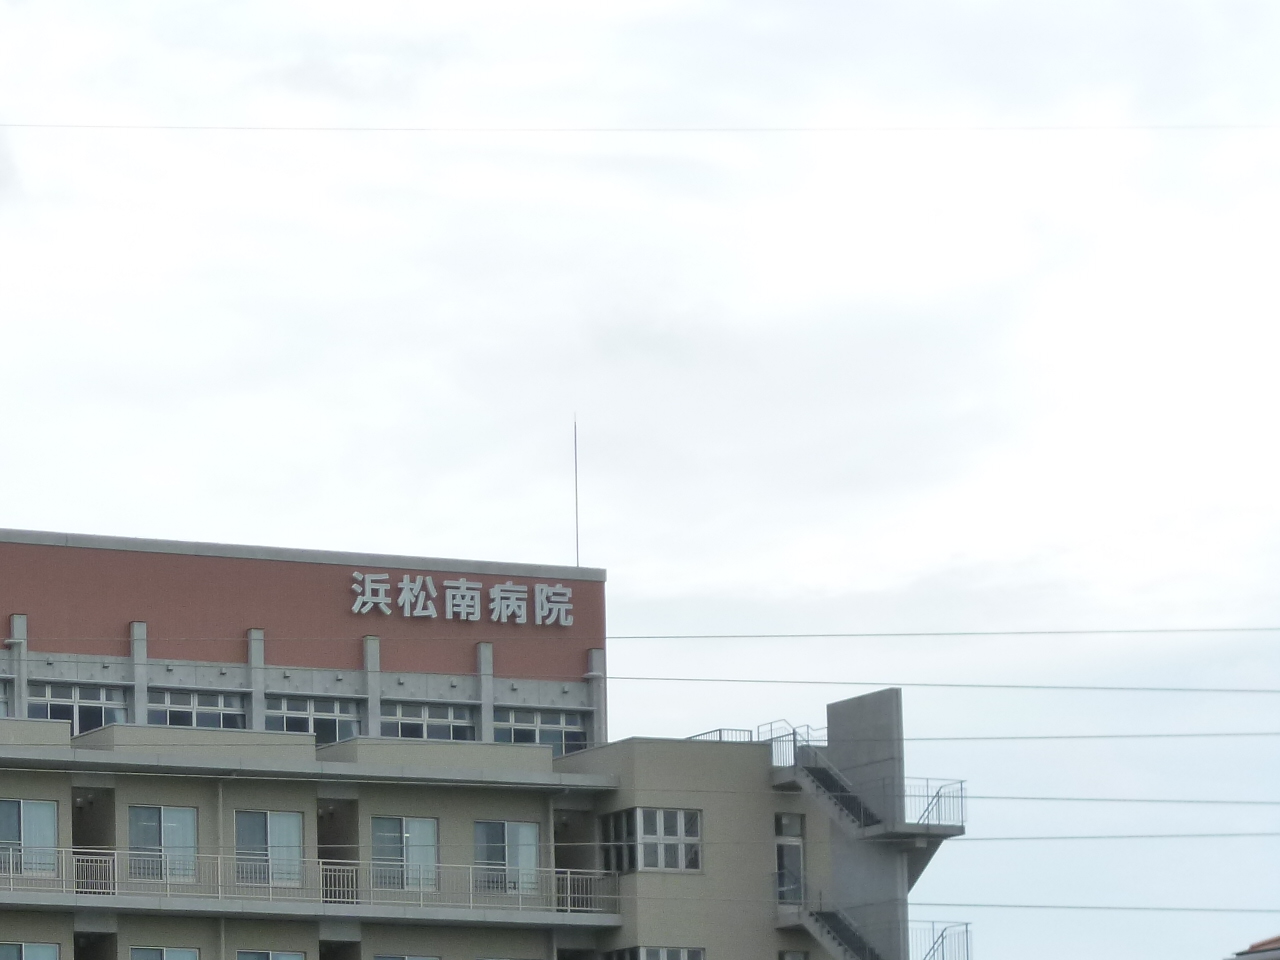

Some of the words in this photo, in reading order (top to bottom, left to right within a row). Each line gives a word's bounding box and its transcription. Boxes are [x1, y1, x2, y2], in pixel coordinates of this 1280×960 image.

[351, 571, 574, 627] 浜松南病院
